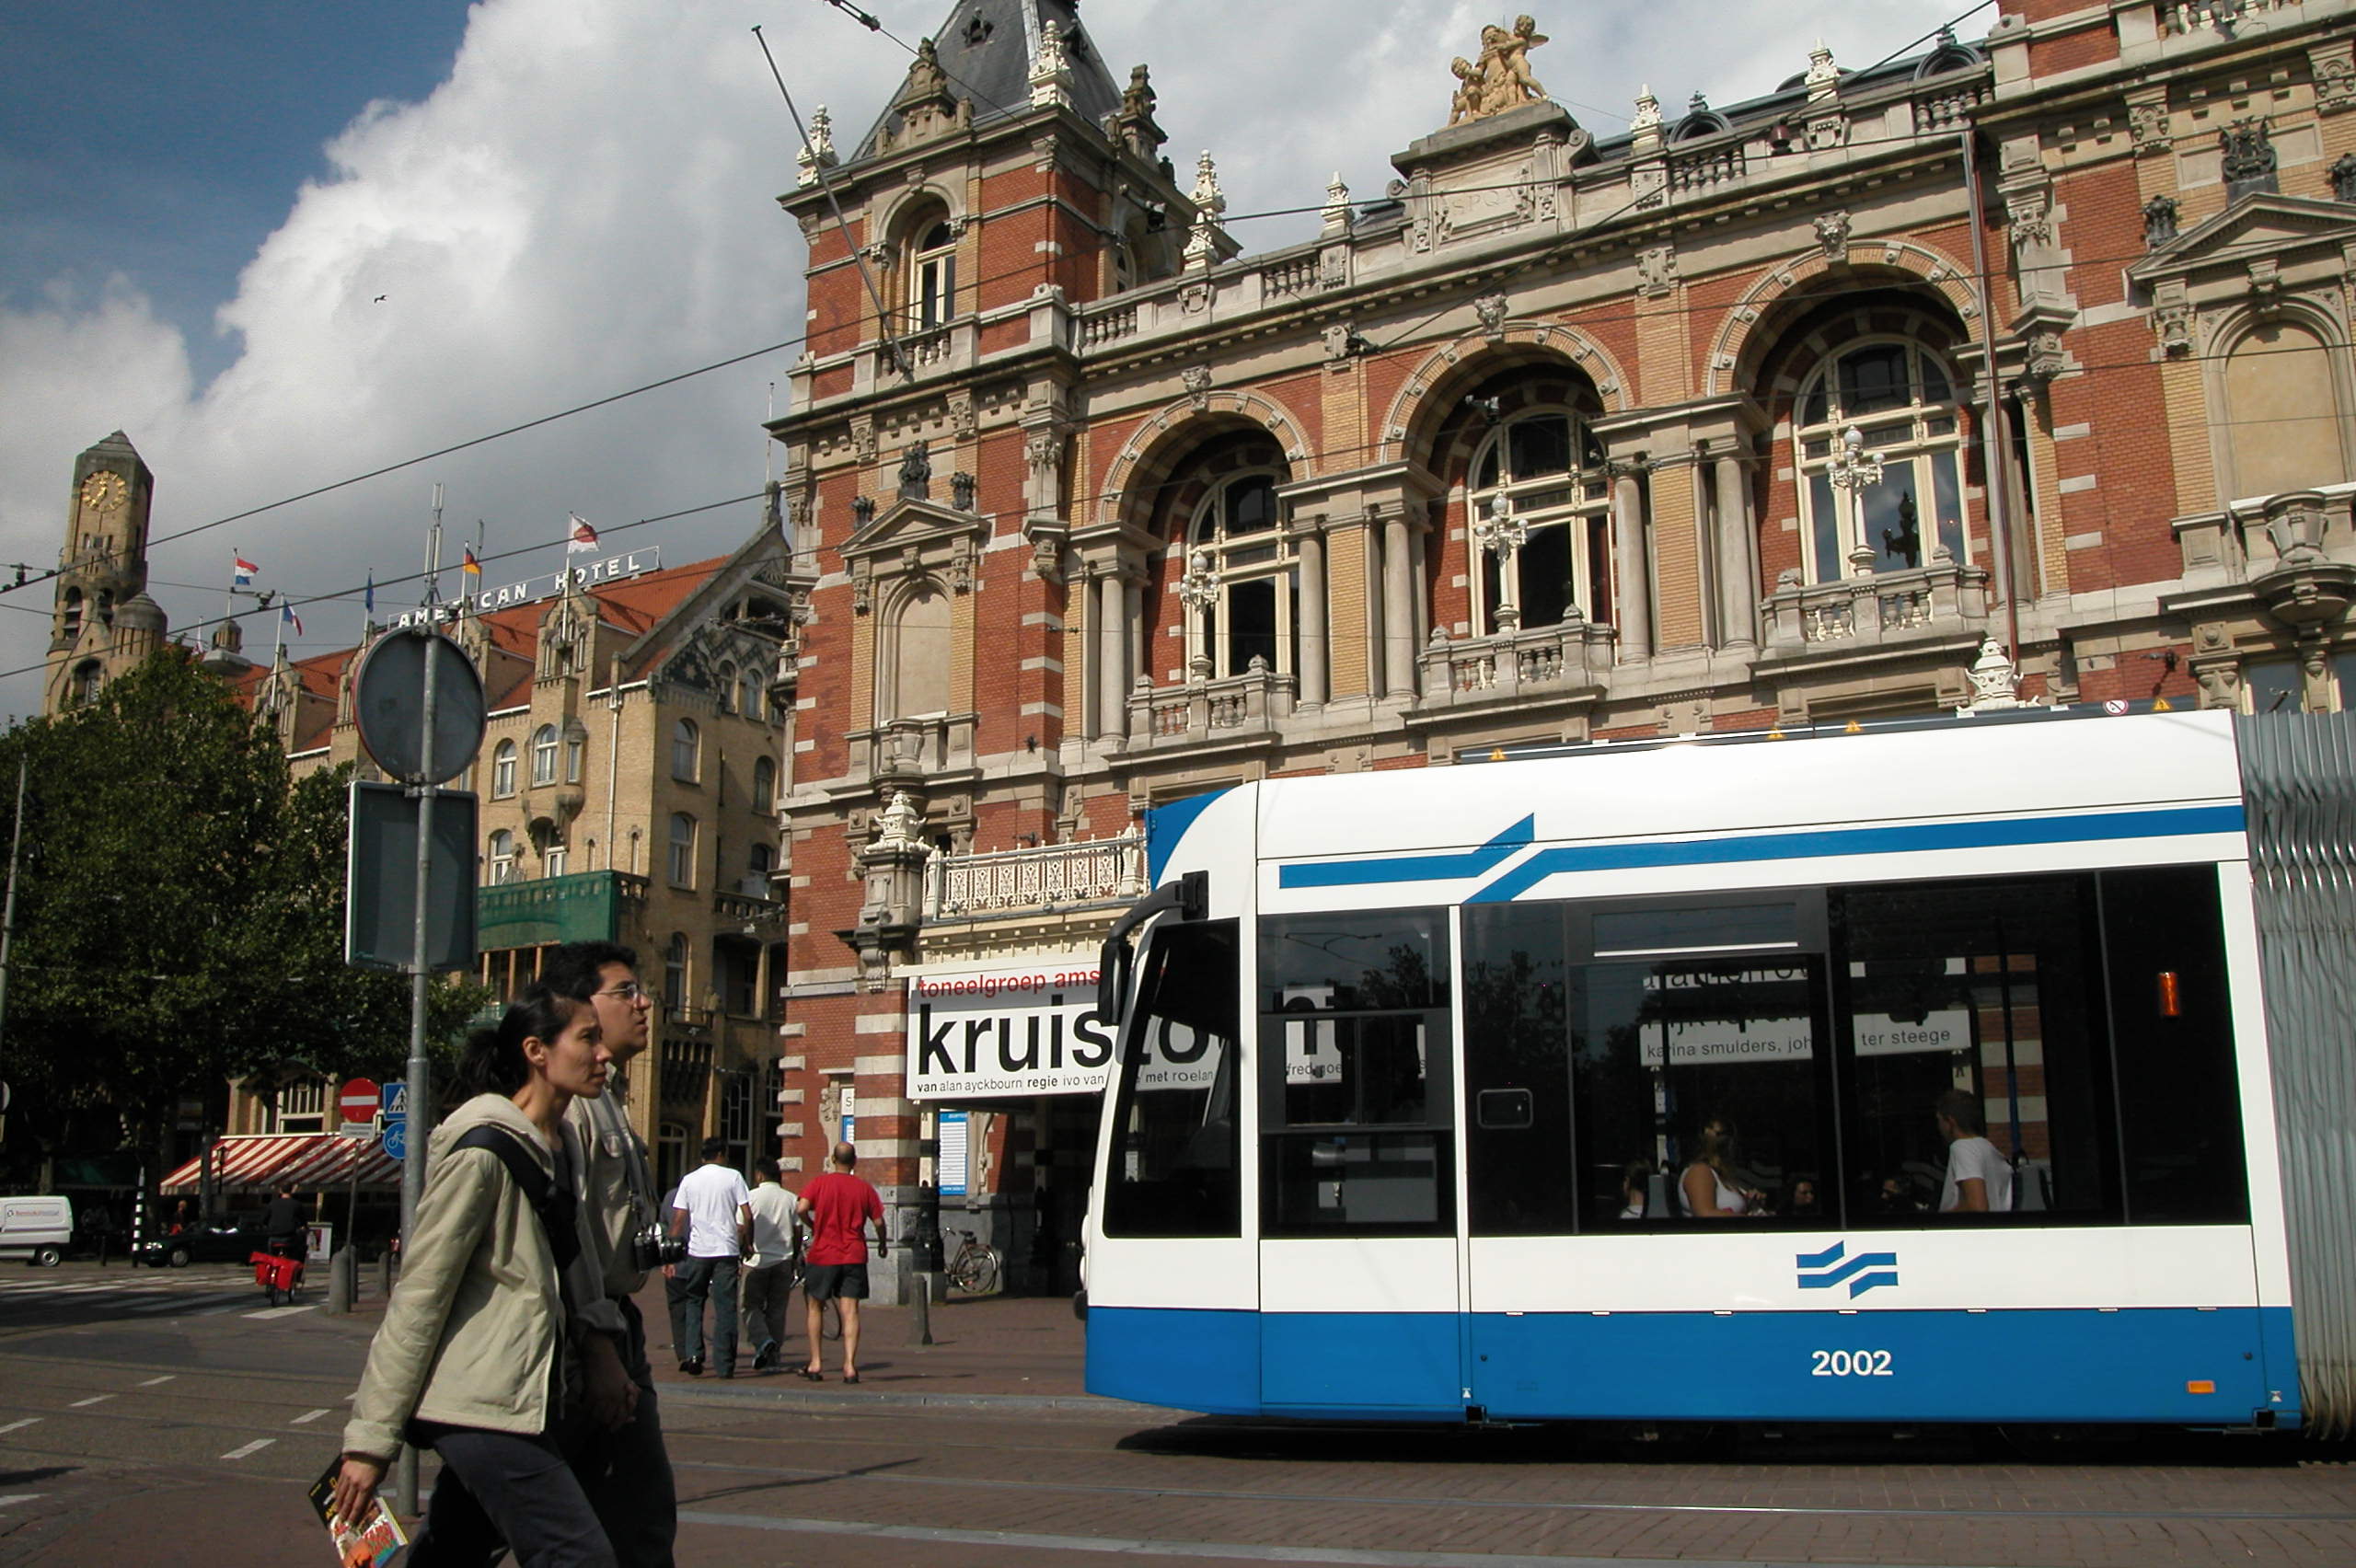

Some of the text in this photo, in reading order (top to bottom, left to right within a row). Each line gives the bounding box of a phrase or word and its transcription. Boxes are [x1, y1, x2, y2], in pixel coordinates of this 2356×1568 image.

[398, 555, 641, 628] AMECAN HOTEL
[919, 969, 1103, 998] toneelgroep ams
[1702, 1039, 1782, 1055] smulders,
[1788, 1036, 1811, 1054] joh
[1862, 1028, 1951, 1046] ter steege
[1286, 1061, 1312, 1076] fred
[918, 1083, 937, 1092] van
[940, 1080, 963, 1090] alan
[964, 1078, 1022, 1093] ayckbourn
[1027, 1075, 1058, 1090] regie
[1063, 1075, 1080, 1086] ivo
[1084, 1074, 1104, 1085] van
[1146, 1070, 1169, 1083] met
[1811, 1349, 1894, 1377] 2002
